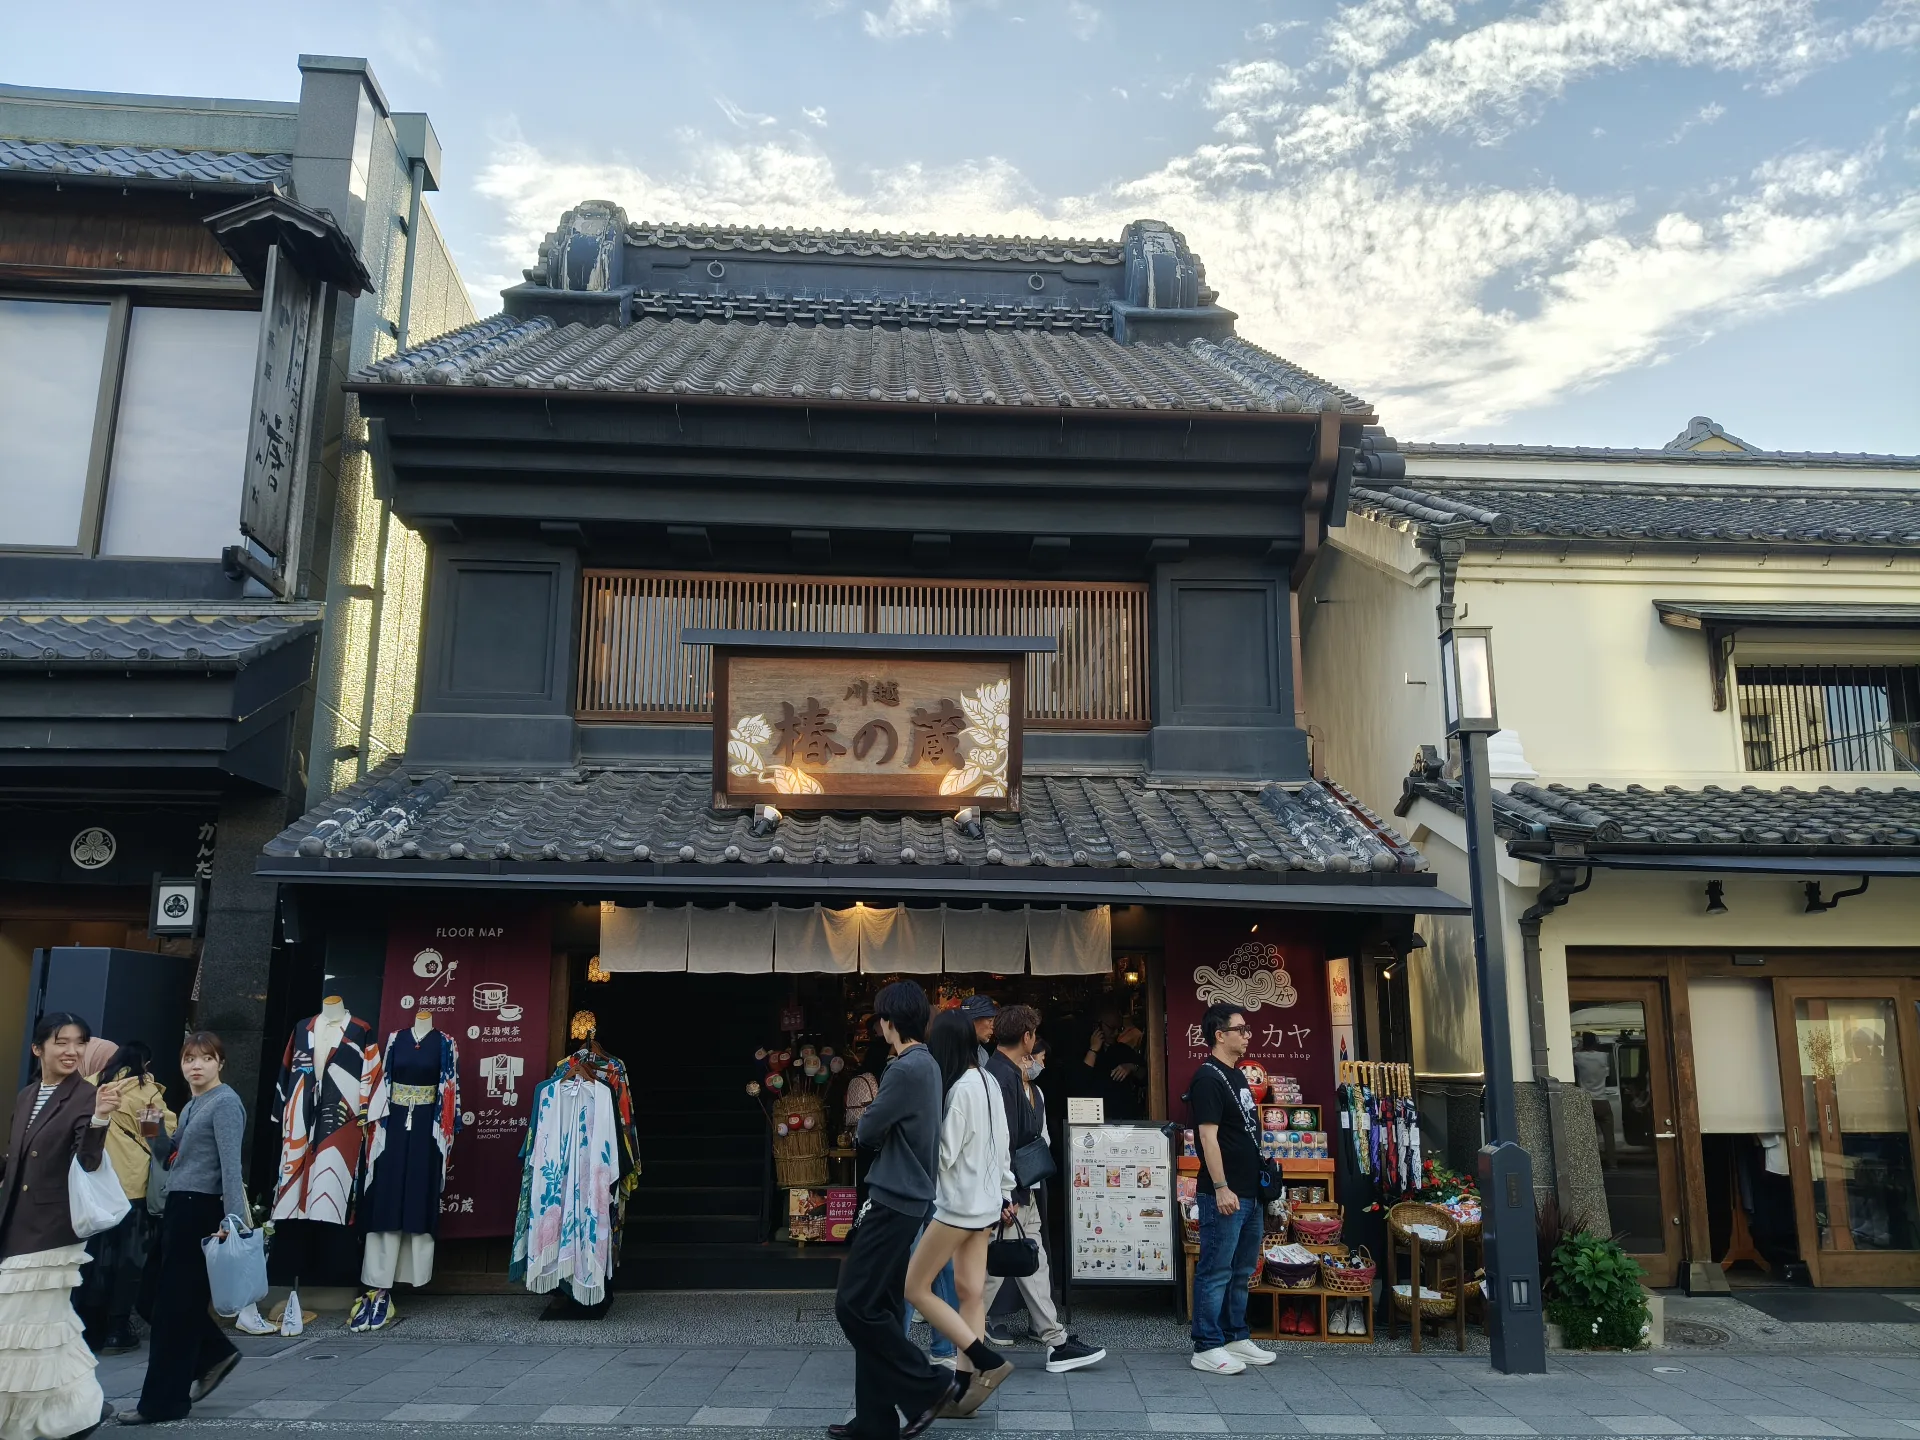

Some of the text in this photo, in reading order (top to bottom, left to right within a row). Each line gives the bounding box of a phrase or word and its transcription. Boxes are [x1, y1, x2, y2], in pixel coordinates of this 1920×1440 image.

[843, 680, 900, 707] 川越
[772, 697, 967, 770] 椿の蔵
[194, 821, 218, 879] かんだ
[436, 927, 475, 938] FLOOR
[1185, 1023, 1312, 1049] 倭カヤ
[1290, 1051, 1311, 1060] shop
[478, 1108, 502, 1117] モダン
